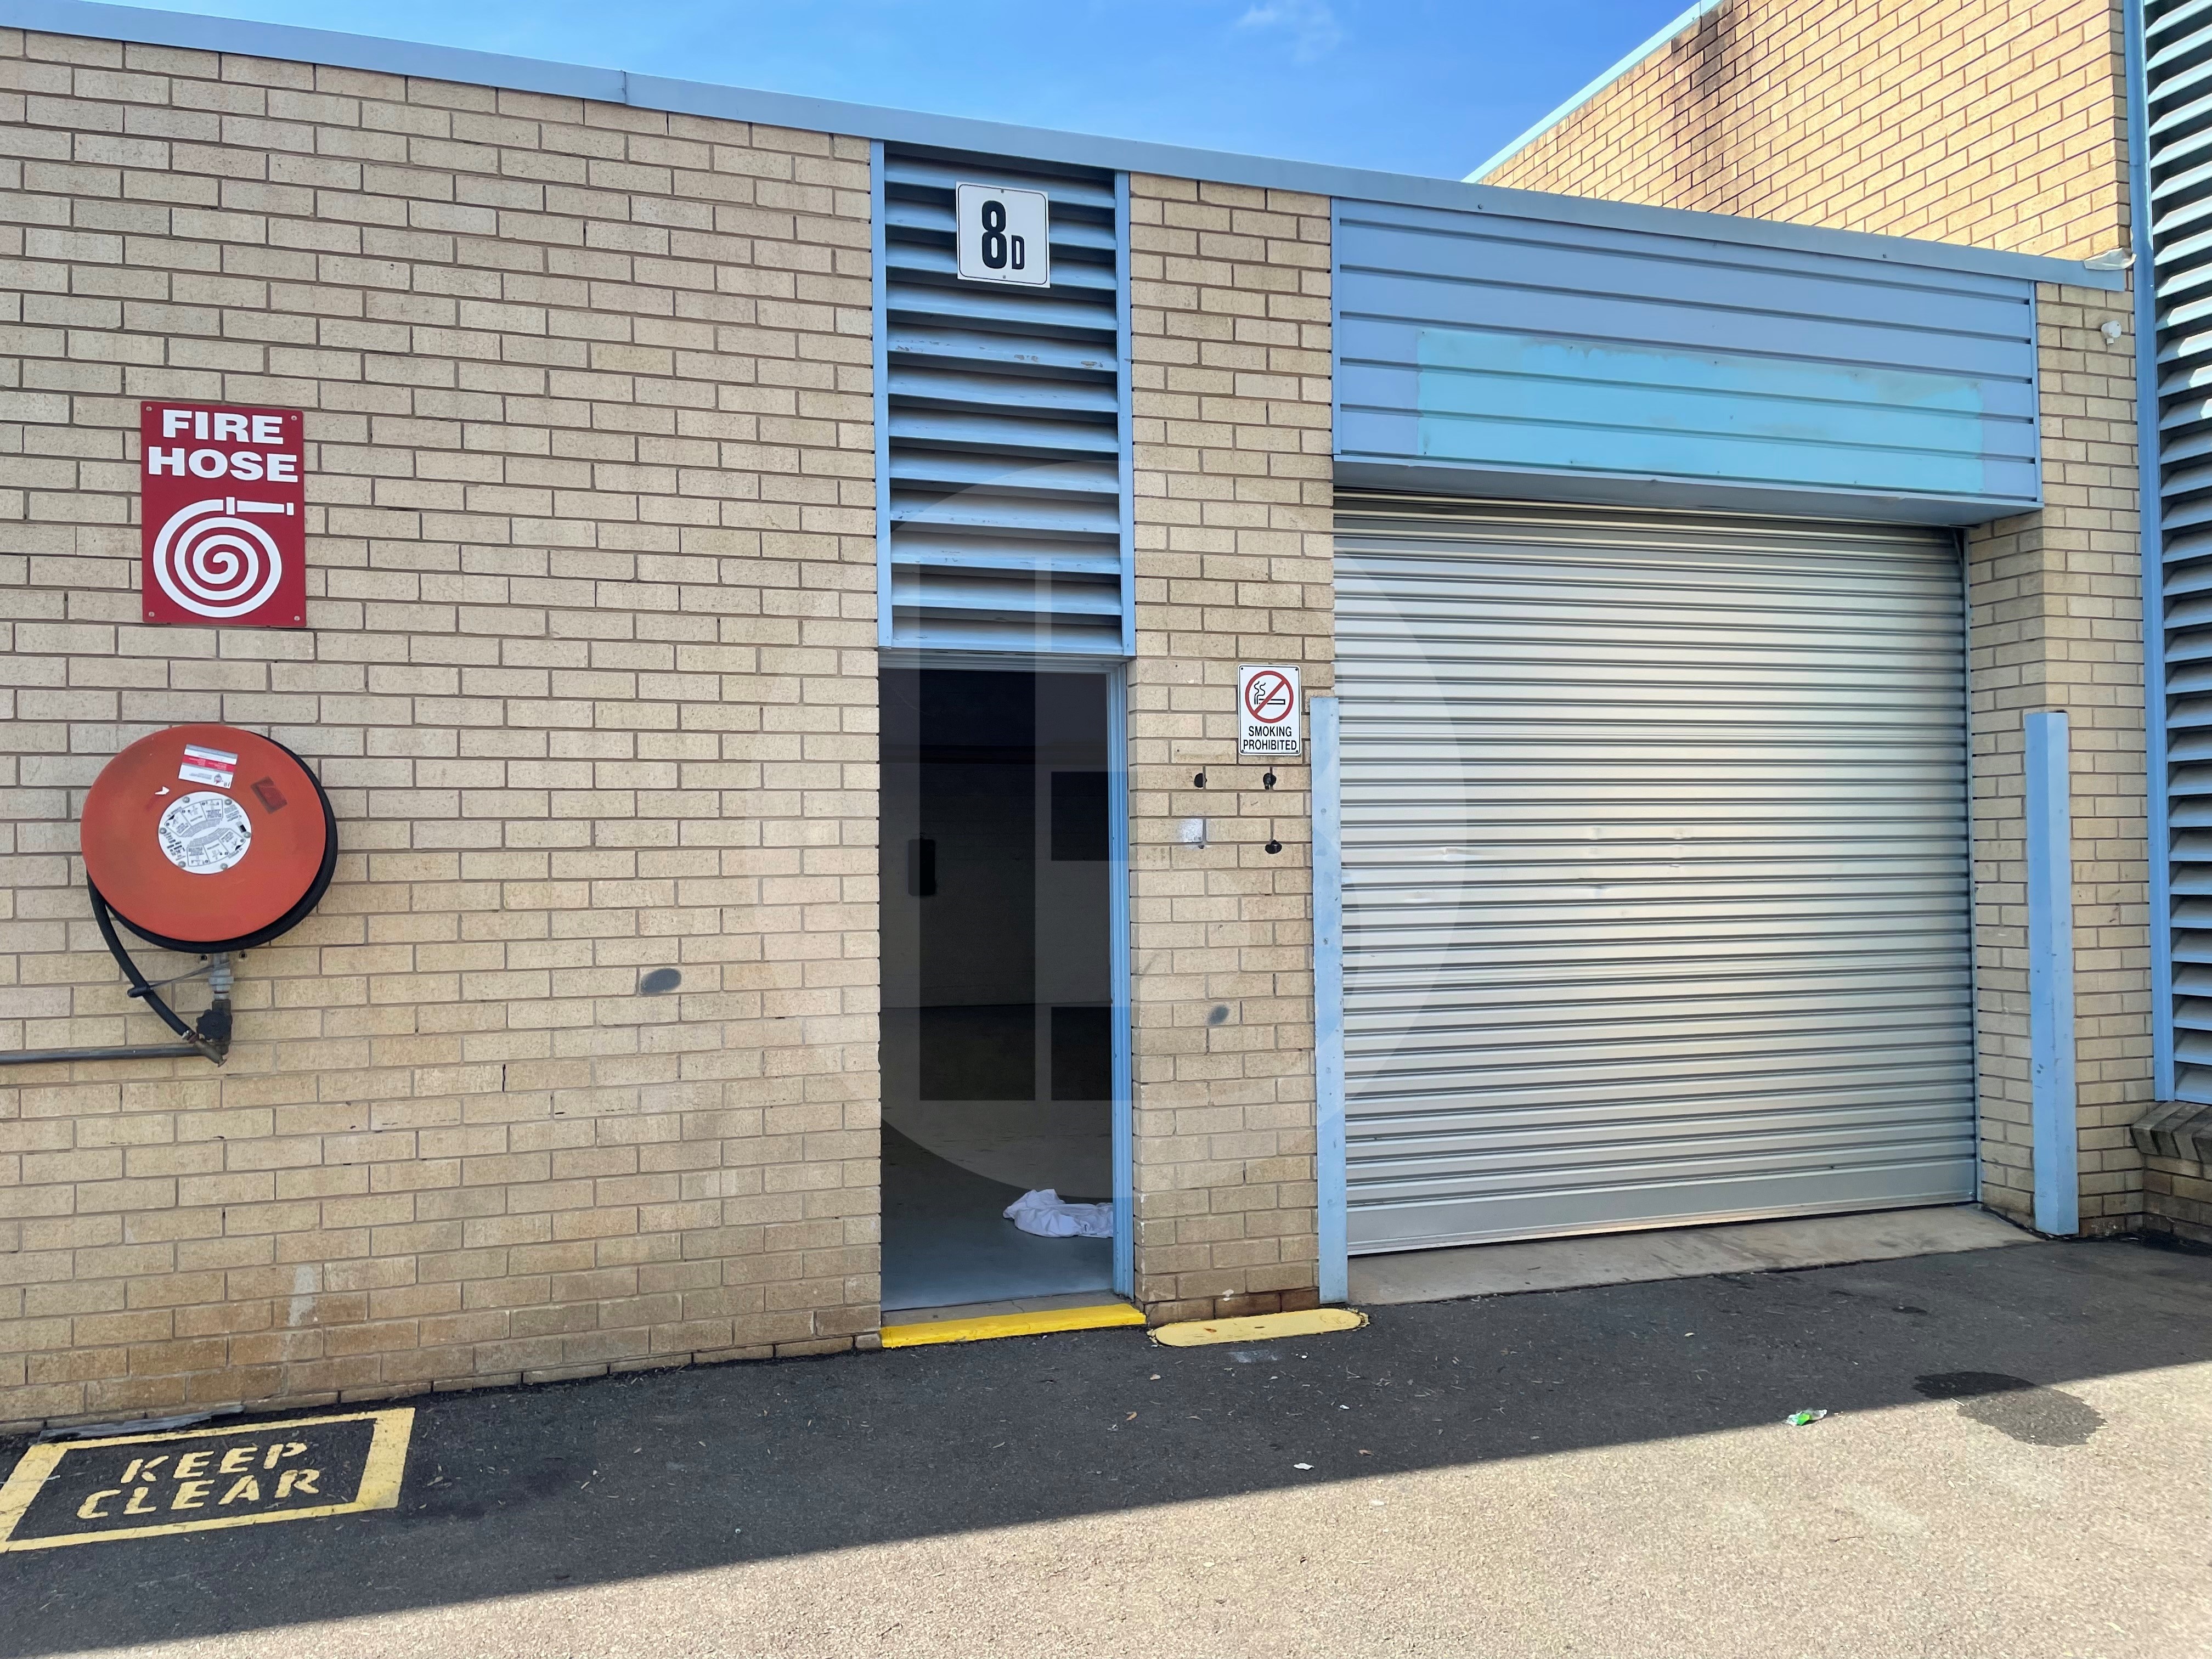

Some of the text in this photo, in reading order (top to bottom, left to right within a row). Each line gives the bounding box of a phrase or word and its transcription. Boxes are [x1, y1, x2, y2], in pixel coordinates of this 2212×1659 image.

[981, 200, 1025, 270] 8D
[162, 409, 284, 445] FIRE
[148, 446, 298, 483] HOSE
[1243, 739, 1297, 751] PROHIBITED
[1248, 725, 1293, 737] SMOKING
[120, 1442, 308, 1484] KEEP
[76, 1468, 321, 1520] CLEAR
